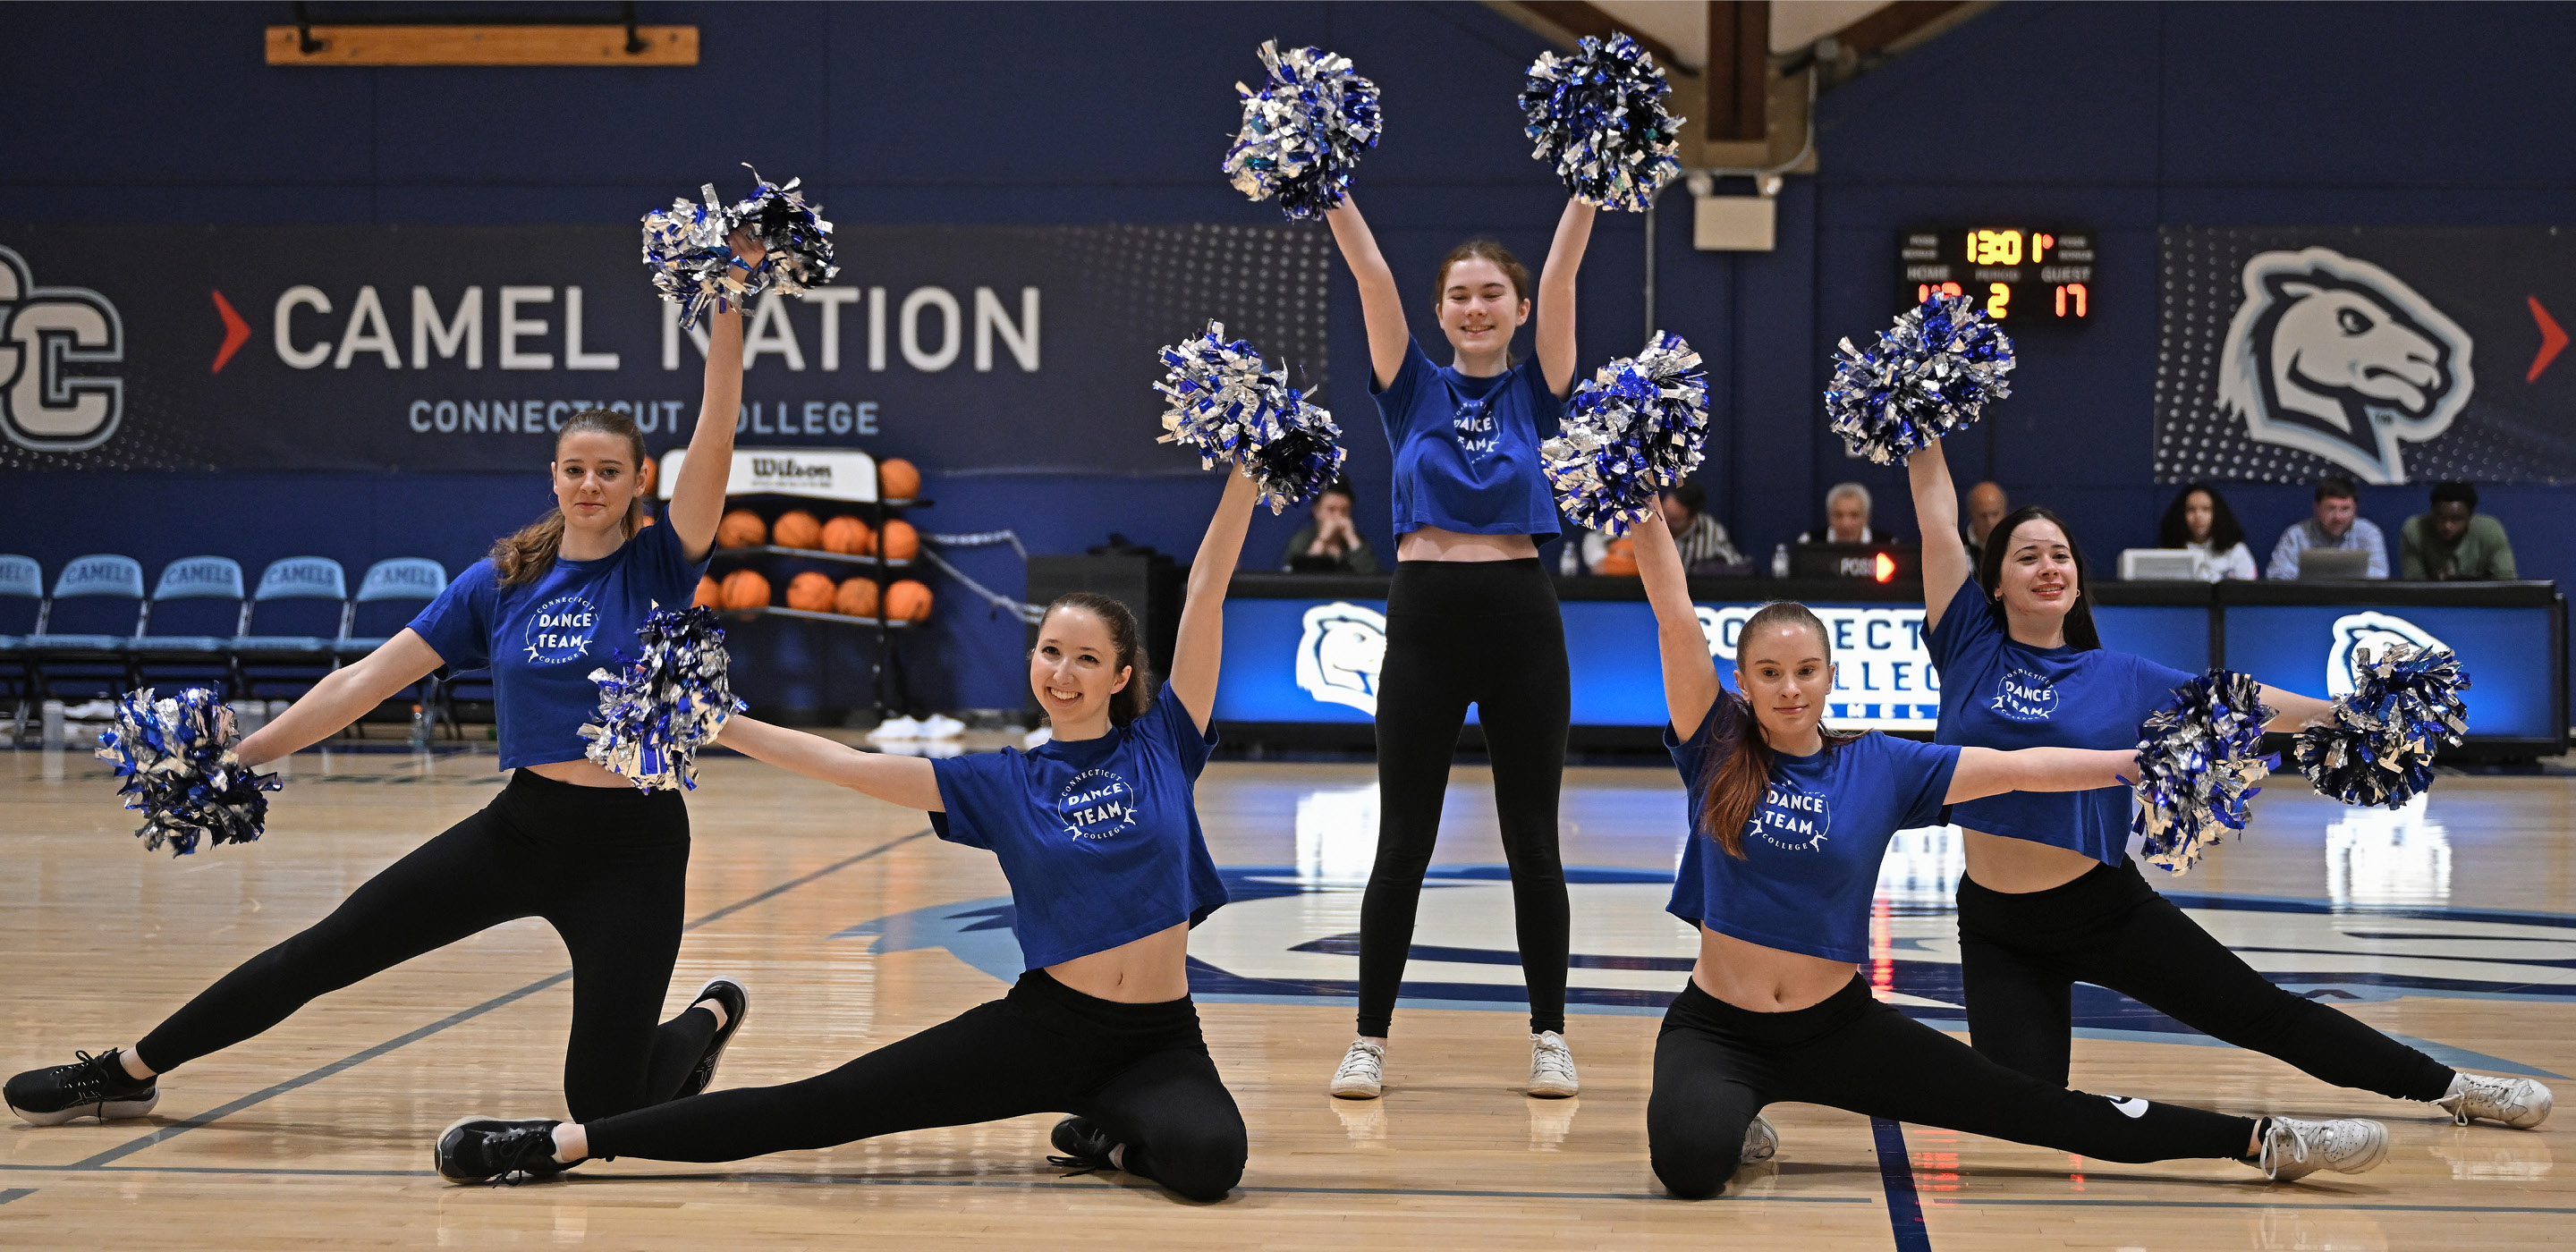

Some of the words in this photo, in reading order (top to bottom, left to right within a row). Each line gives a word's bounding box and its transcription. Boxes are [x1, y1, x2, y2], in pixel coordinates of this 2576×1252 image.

[1907, 265, 1951, 282] HOME
[1975, 269, 2021, 283] PERIOD
[2041, 266, 2092, 283] GUEST
[1987, 282, 2011, 319] 2
[2055, 283, 2088, 317] 17
[274, 284, 621, 371] CAMEL
[662, 285, 1041, 373] NATION
[0, 244, 124, 453] C
[409, 400, 684, 435] CONNECUT
[735, 401, 880, 436] LLEGE
[751, 458, 833, 478] Wilson
[65, 563, 134, 584] CAMELS
[165, 564, 238, 585] CAMELS
[538, 613, 592, 628] DANCE
[538, 633, 582, 648] TEAM
[538, 653, 580, 664] COLLEGE
[2005, 681, 2051, 702] DANCE
[1061, 768, 1123, 797] CONNECTICUT
[1068, 782, 1123, 807] DANCE
[1767, 790, 1824, 814] DANCE
[1073, 800, 1122, 827] TEAM
[1765, 810, 1813, 835] TEAM
[1083, 824, 1126, 840] COLLEGE
[1762, 833, 1808, 850] COLLEGE
